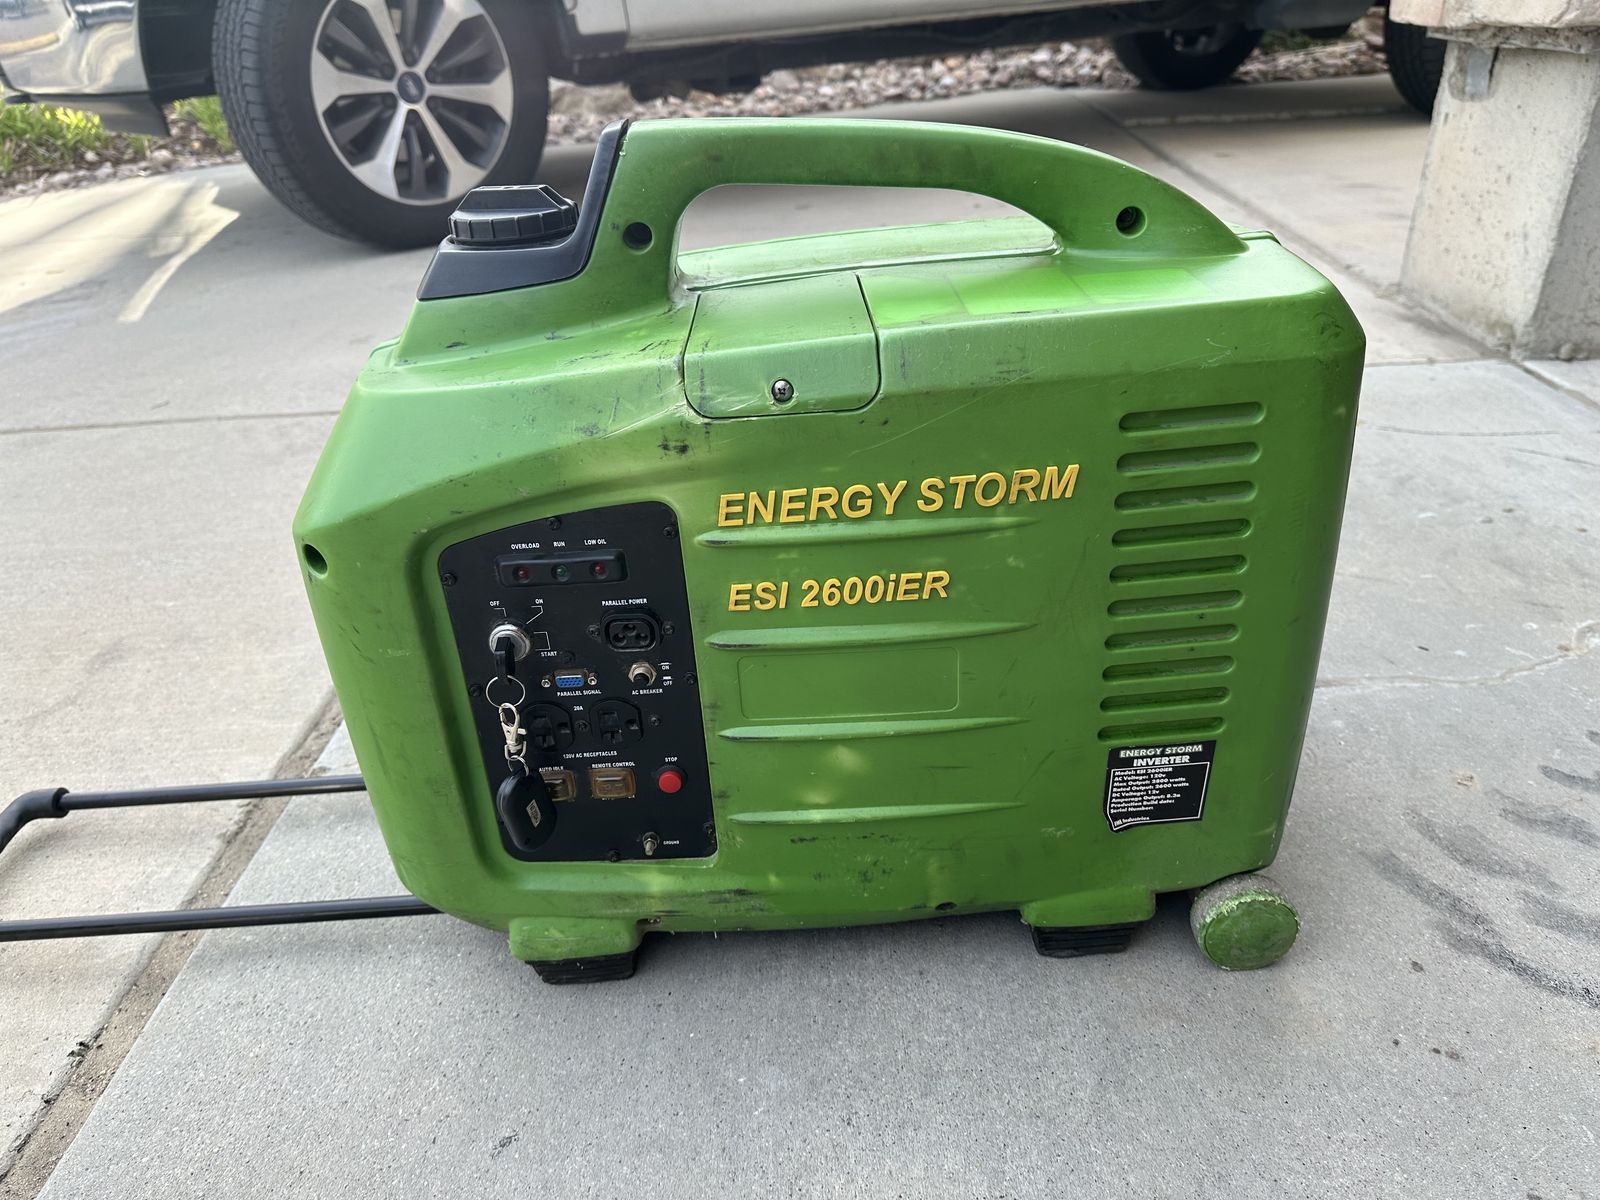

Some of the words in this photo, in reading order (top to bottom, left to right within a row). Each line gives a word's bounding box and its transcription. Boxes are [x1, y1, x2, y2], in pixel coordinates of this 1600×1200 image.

[718, 480, 907, 527] ENERGY
[917, 464, 1080, 512] STORM
[728, 581, 789, 612] ESI
[801, 570, 950, 608] 2600iER
[1120, 748, 1162, 758] ENERGY
[1164, 744, 1203, 755] STORM
[1132, 755, 1190, 767] INVERTER
